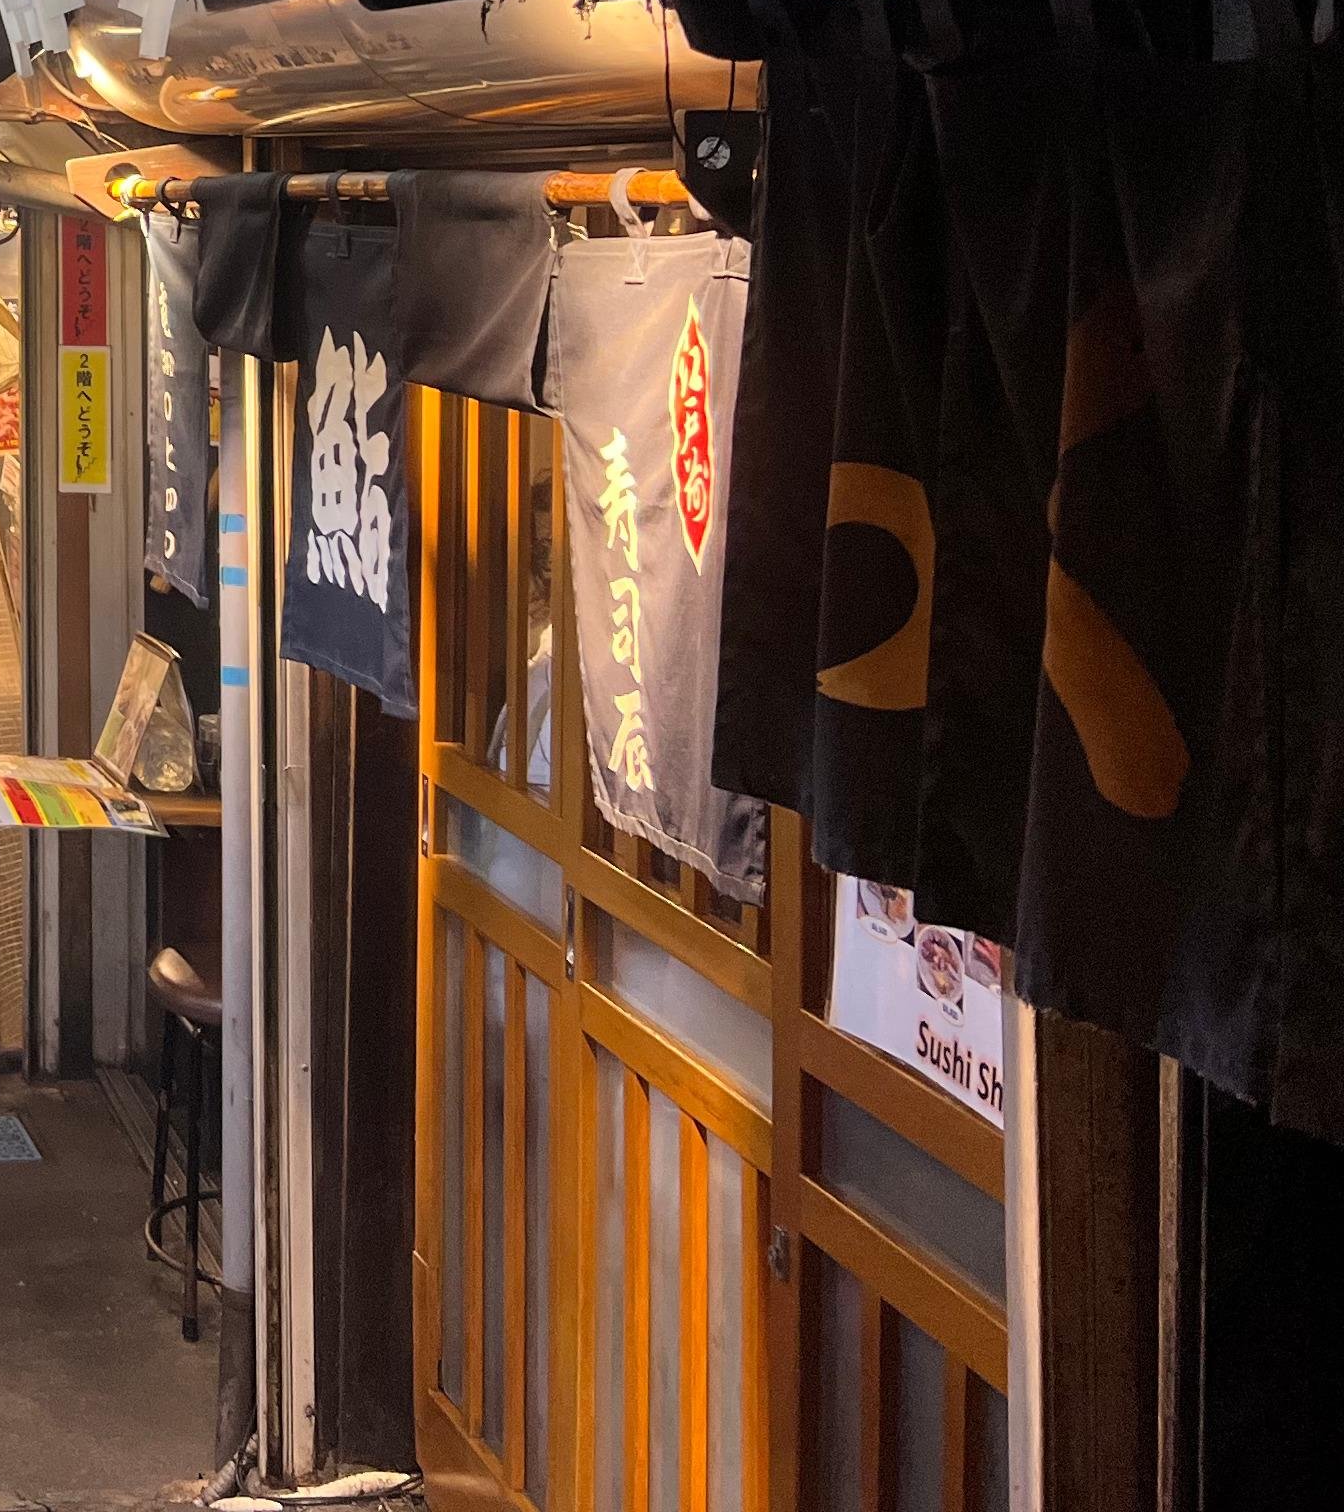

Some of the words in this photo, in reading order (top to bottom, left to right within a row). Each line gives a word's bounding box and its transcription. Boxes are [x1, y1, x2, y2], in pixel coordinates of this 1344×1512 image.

[76, 353, 93, 457] 2階へどうぞ
[598, 427, 654, 793] 寿司辰
[916, 1020, 971, 1090] Sushi
